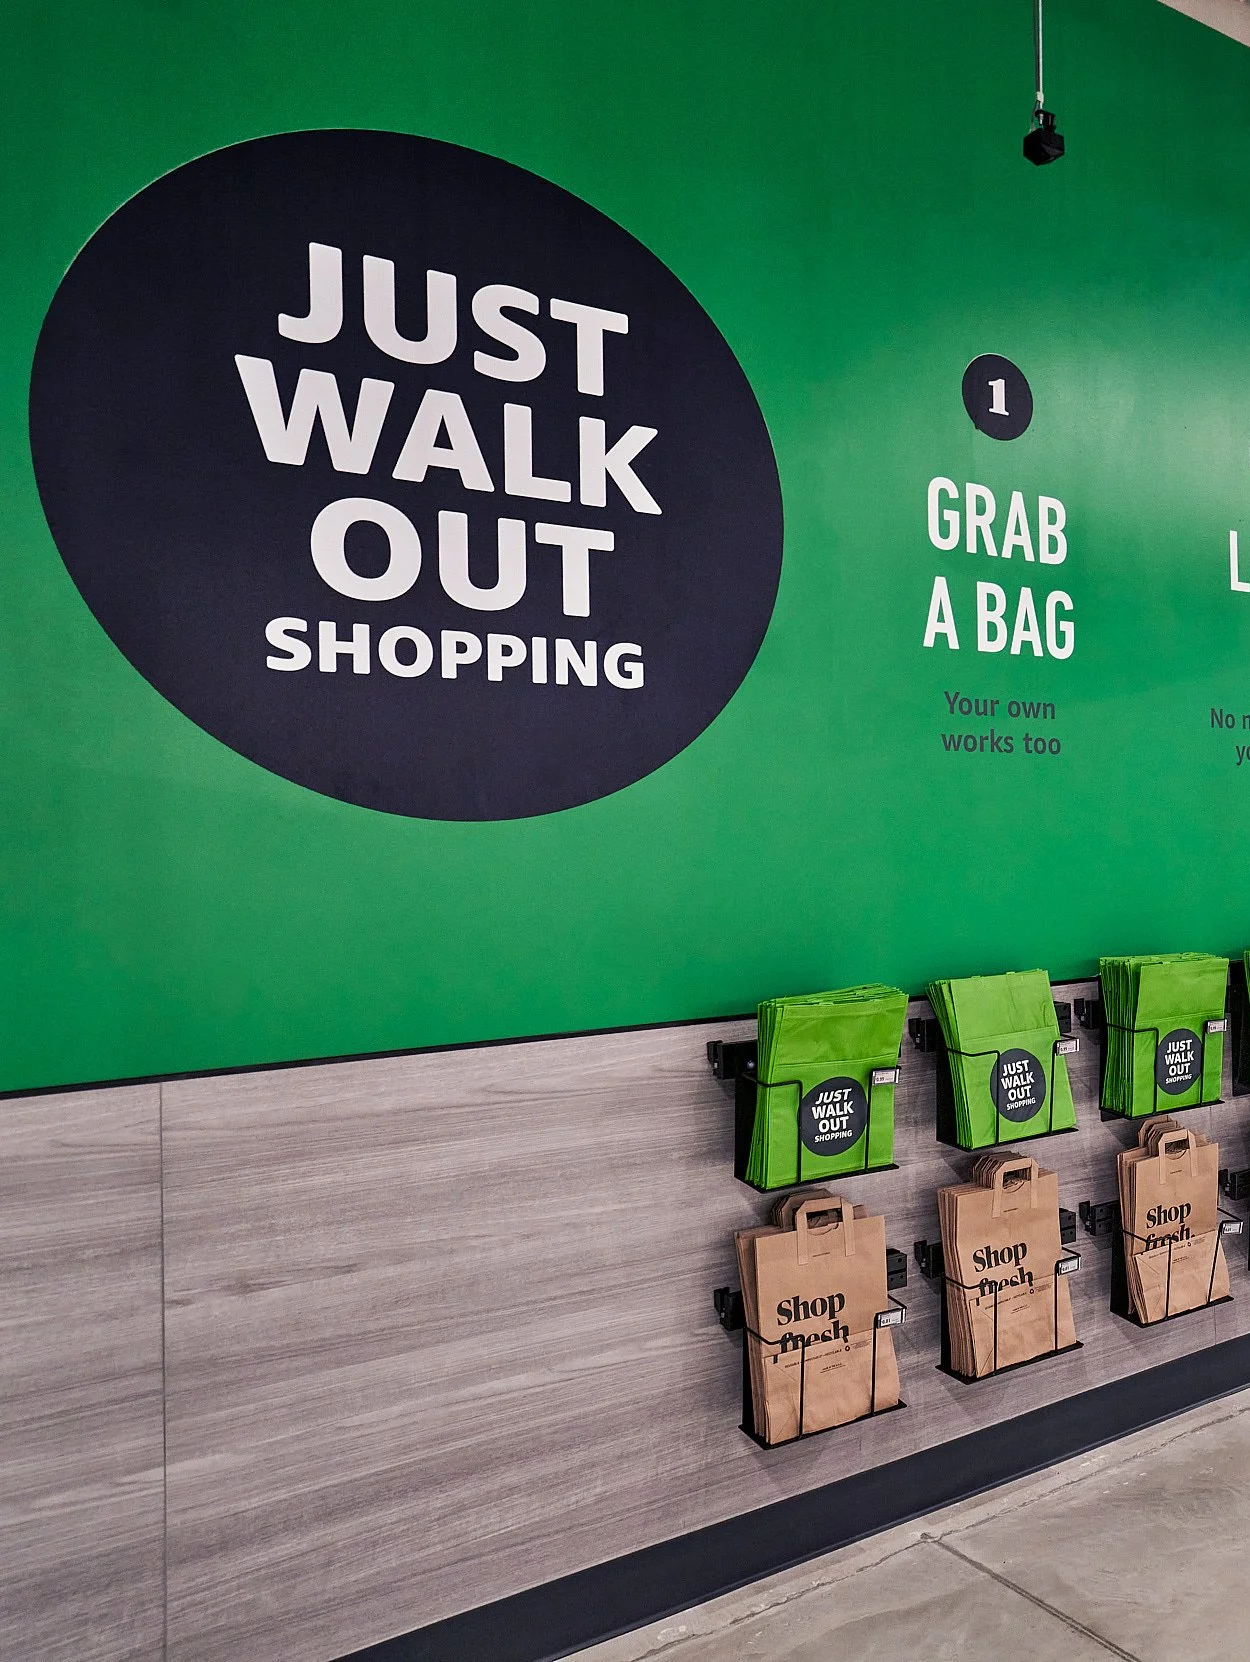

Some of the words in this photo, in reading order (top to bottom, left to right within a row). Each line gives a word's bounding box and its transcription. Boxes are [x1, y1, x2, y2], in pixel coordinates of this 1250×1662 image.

[278, 242, 629, 397] JUST
[988, 378, 1010, 416] 1
[234, 354, 662, 515] WALK
[927, 476, 1068, 565] GRAB
[310, 497, 615, 618] OUT
[923, 576, 960, 650] A
[976, 581, 1075, 660] BAG
[265, 616, 645, 690] SHOPPING
[943, 690, 1001, 717] Your
[1007, 700, 1056, 720] own
[1210, 708, 1236, 729] No
[940, 728, 1014, 754] works
[1022, 732, 1062, 755] too
[1164, 1050, 1195, 1066] WALK
[1166, 1039, 1193, 1054] JUST
[1002, 1059, 1030, 1077] JUST
[1168, 1062, 1191, 1077] OUT
[1000, 1071, 1035, 1090] WALK
[814, 1087, 853, 1105] JUST
[1006, 1097, 1036, 1111] SHOPPING
[1007, 1085, 1032, 1101] OUT
[811, 1100, 855, 1120] WALK
[814, 1129, 853, 1143] SHOPPING
[818, 1115, 850, 1133] OUT
[1145, 1202, 1192, 1230] Shop
[972, 1241, 1028, 1273] Shop
[776, 1291, 846, 1326] Shop
